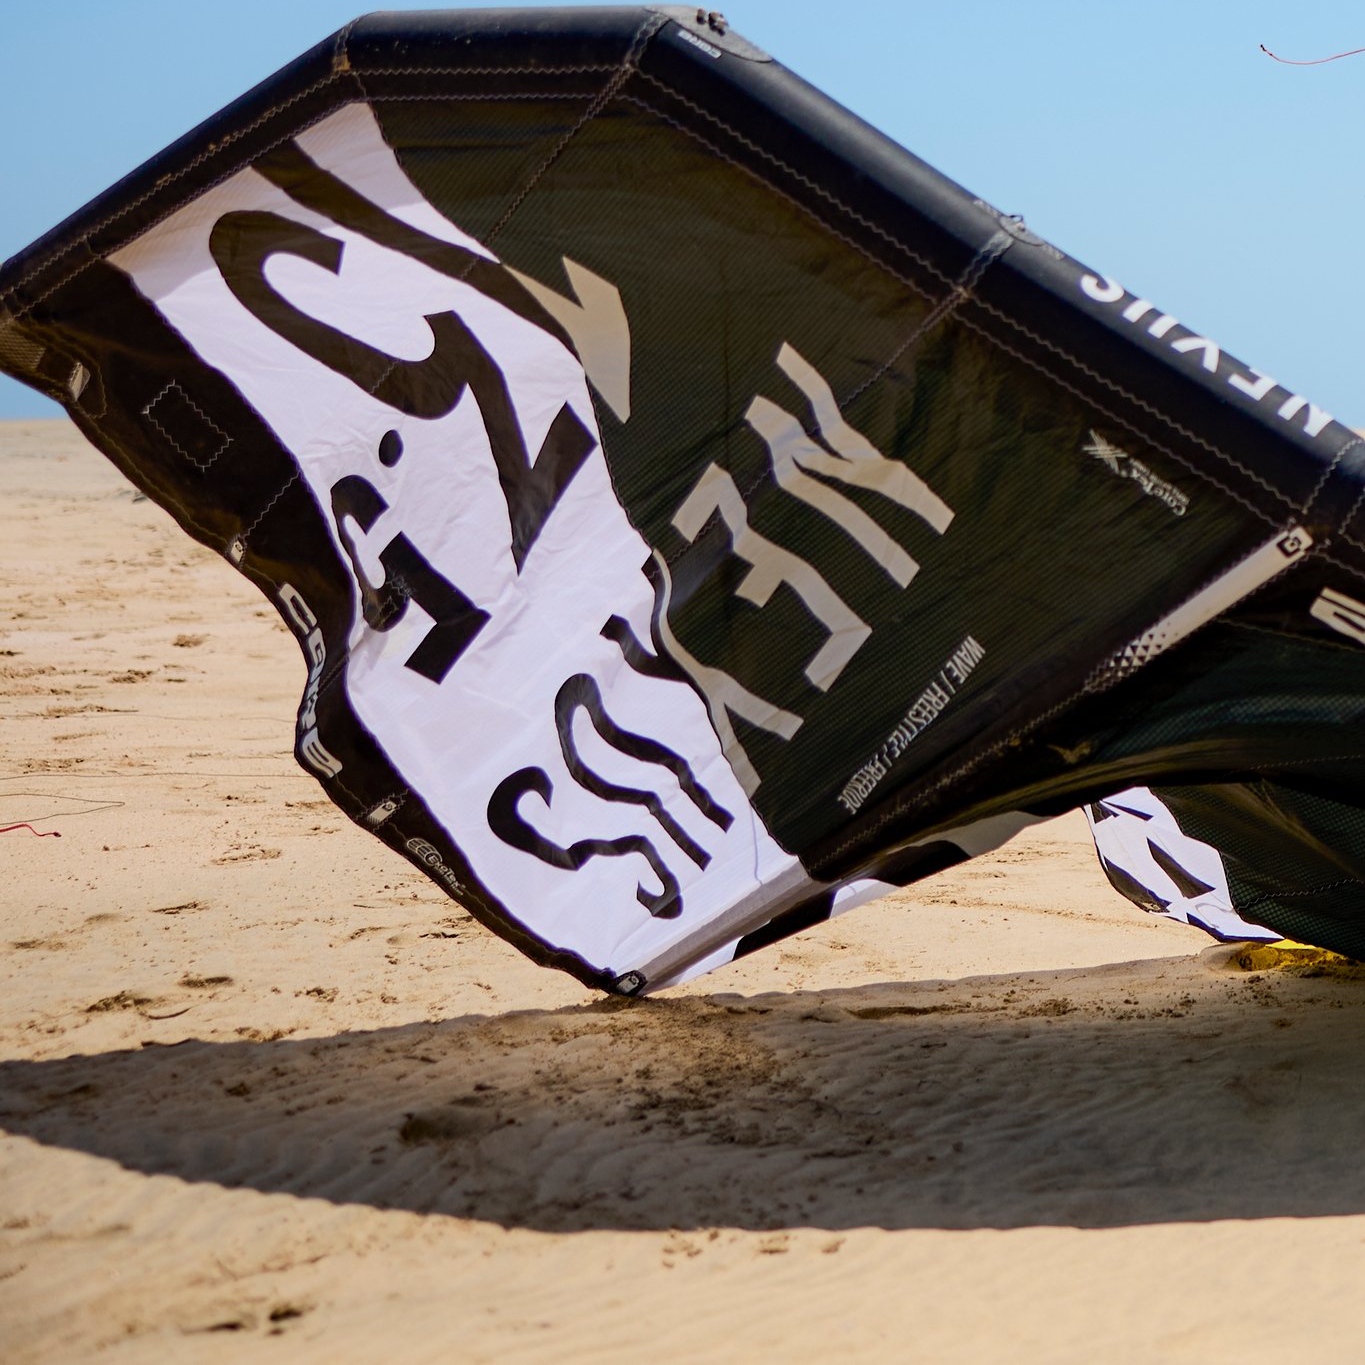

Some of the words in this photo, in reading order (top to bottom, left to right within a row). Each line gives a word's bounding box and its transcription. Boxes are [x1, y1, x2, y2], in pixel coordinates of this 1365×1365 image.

[209, 138, 632, 683] 13.5
[279, 583, 343, 779] CORE
[488, 340, 955, 918] NEXUS
[946, 635, 986, 684] WAVE
[837, 753, 888, 816] FREERIDE
[888, 681, 950, 759] FREESTYLE
